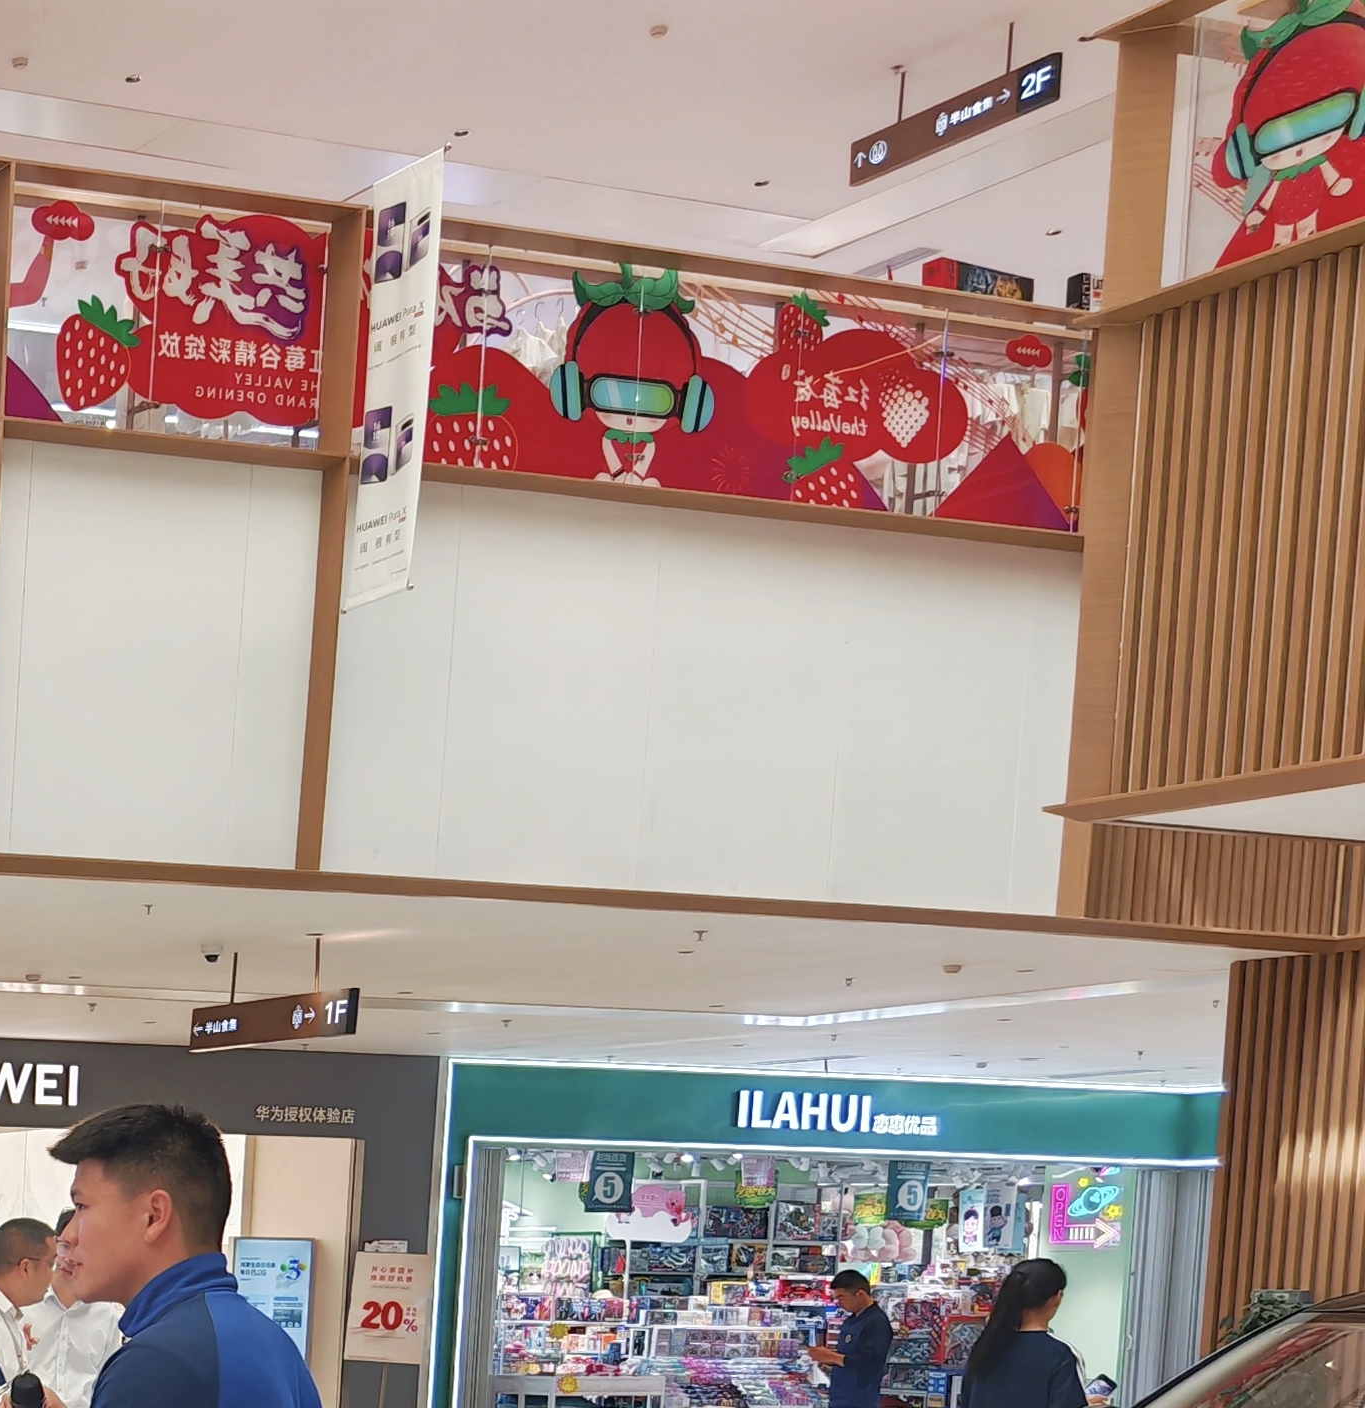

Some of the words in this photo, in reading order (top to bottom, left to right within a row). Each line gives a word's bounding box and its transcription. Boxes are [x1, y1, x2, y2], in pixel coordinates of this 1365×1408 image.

[1020, 65, 1052, 100] 2F
[370, 311, 402, 334] HUAWEI
[356, 514, 388, 535] HUAWEI
[325, 1000, 348, 1025] 1F
[256, 1105, 356, 1125] 华为授权体验店
[737, 1090, 871, 1132] ILAHUI
[602, 1176, 615, 1199] 5
[906, 1185, 918, 1206] 5
[1055, 1187, 1066, 1240] OPEN
[360, 1300, 403, 1330] 20
[403, 1318, 418, 1333] %
